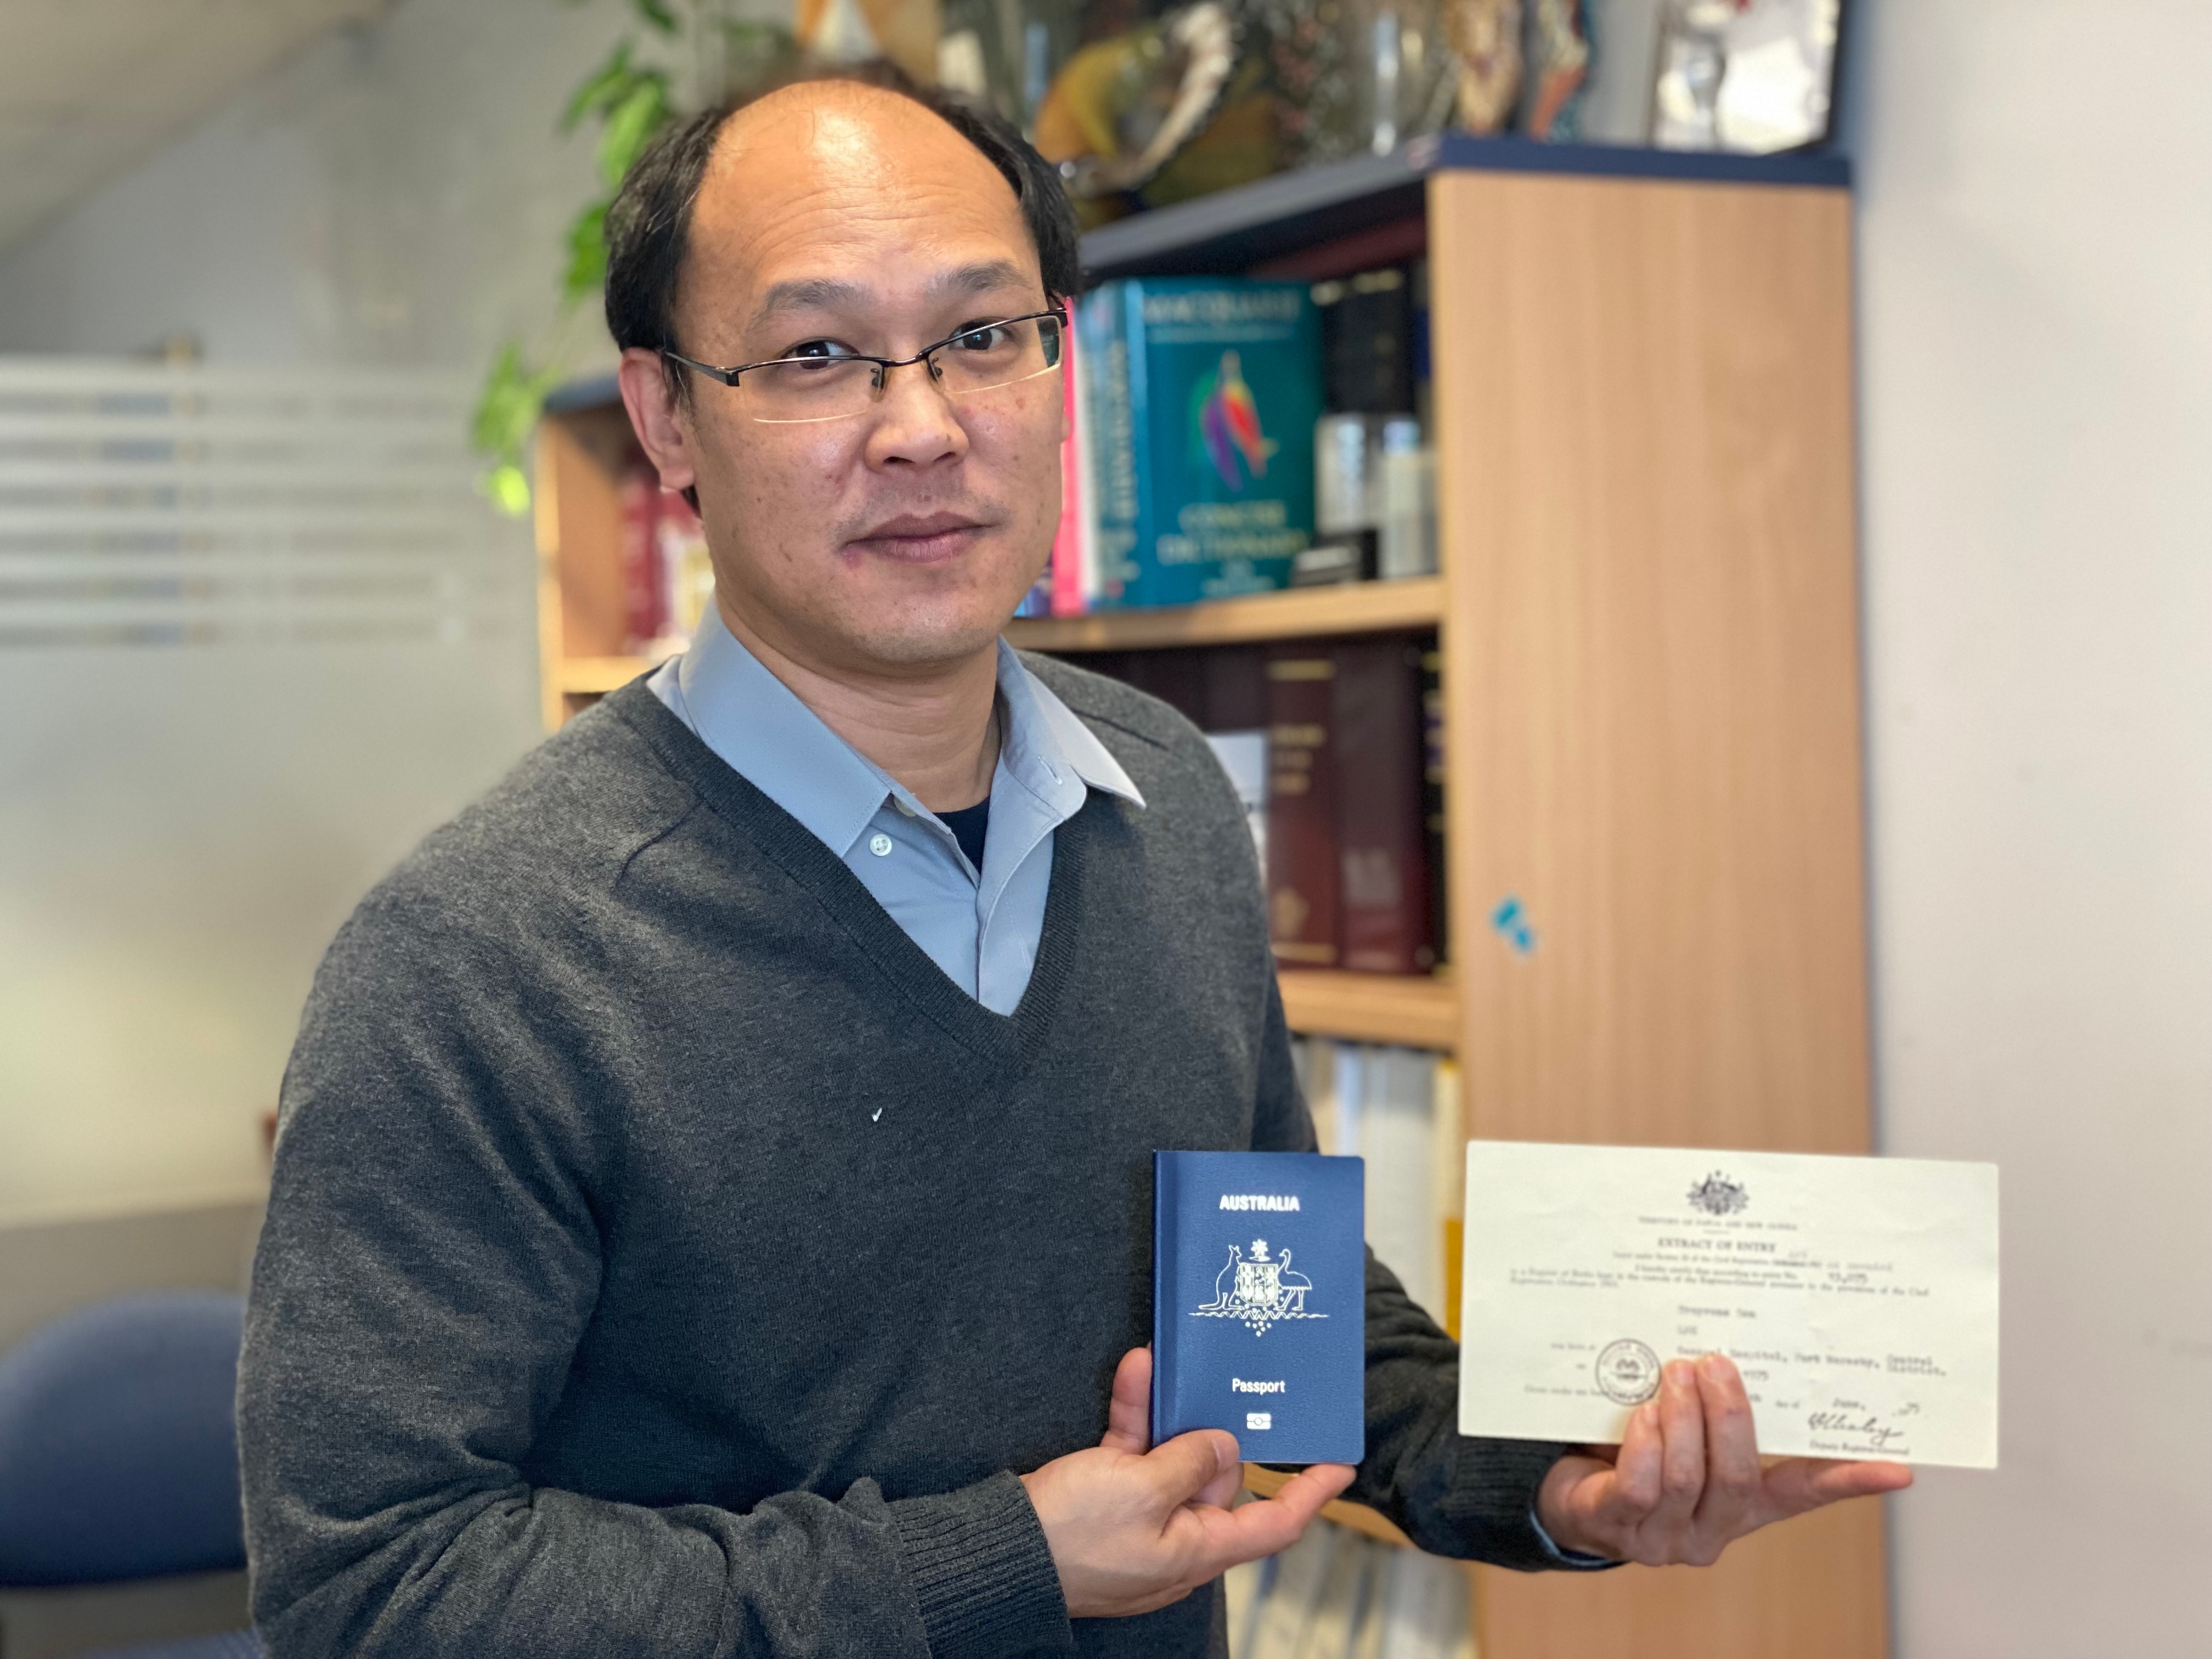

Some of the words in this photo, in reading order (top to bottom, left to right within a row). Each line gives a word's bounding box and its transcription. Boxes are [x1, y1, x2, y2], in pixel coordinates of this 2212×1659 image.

[1178, 500, 1287, 531] CONCISE
[1156, 529, 1308, 565] DICTIONARY
[1219, 1195, 1300, 1211] AUSTRALIA
[1658, 1238, 1712, 1249] EXTRACT
[1717, 1241, 1732, 1250] OF
[1737, 1242, 1775, 1252] ENTRY
[1232, 1378, 1285, 1395] Passport
